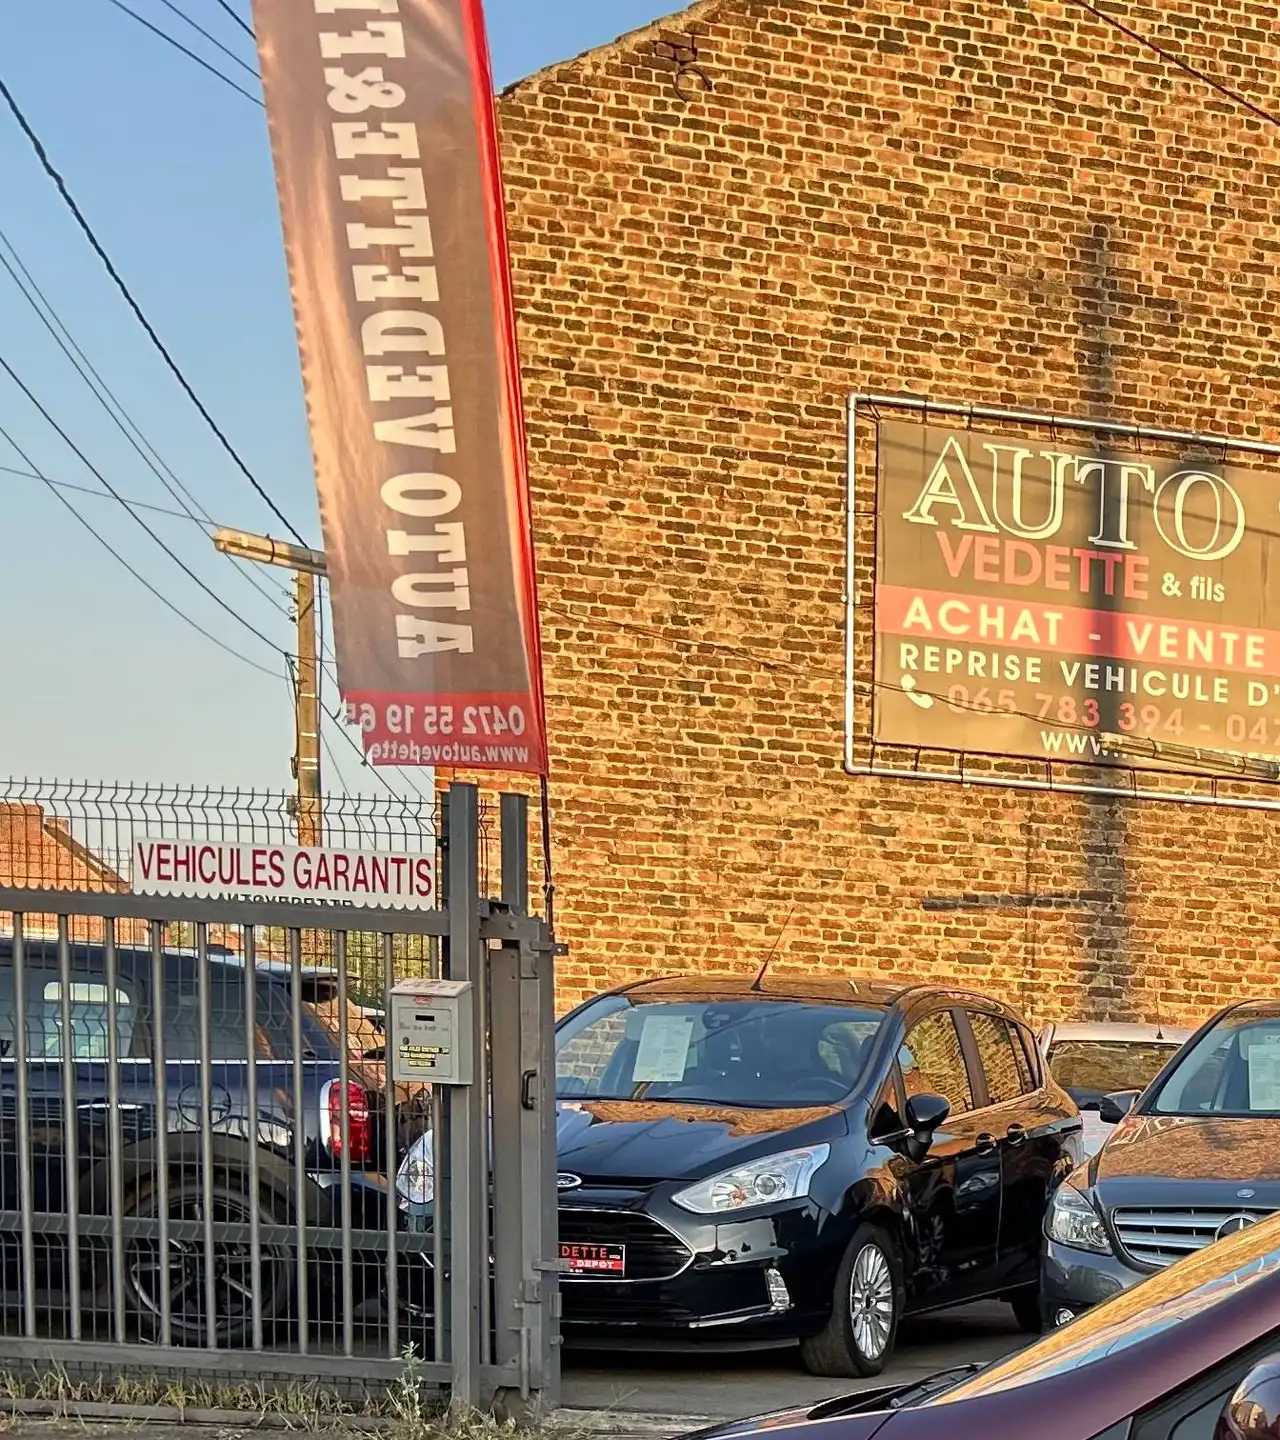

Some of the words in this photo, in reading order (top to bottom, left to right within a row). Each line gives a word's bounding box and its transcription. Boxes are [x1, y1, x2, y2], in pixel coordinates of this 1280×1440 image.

[902, 435, 1246, 561] AUTO
[936, 531, 1150, 600] VEDETTE
[1160, 572, 1182, 597] &
[1189, 574, 1226, 603] fils
[902, 596, 1064, 646] ACHAT
[1125, 620, 1265, 669] VENTE
[900, 643, 1043, 684] REPRISE
[1059, 660, 1229, 704] VEHICULE
[947, 683, 1018, 719] 065
[1035, 692, 1100, 728] 783
[1118, 702, 1184, 737] 394
[137, 842, 285, 888] VEHICULES
[293, 851, 433, 898] GARANTIS
